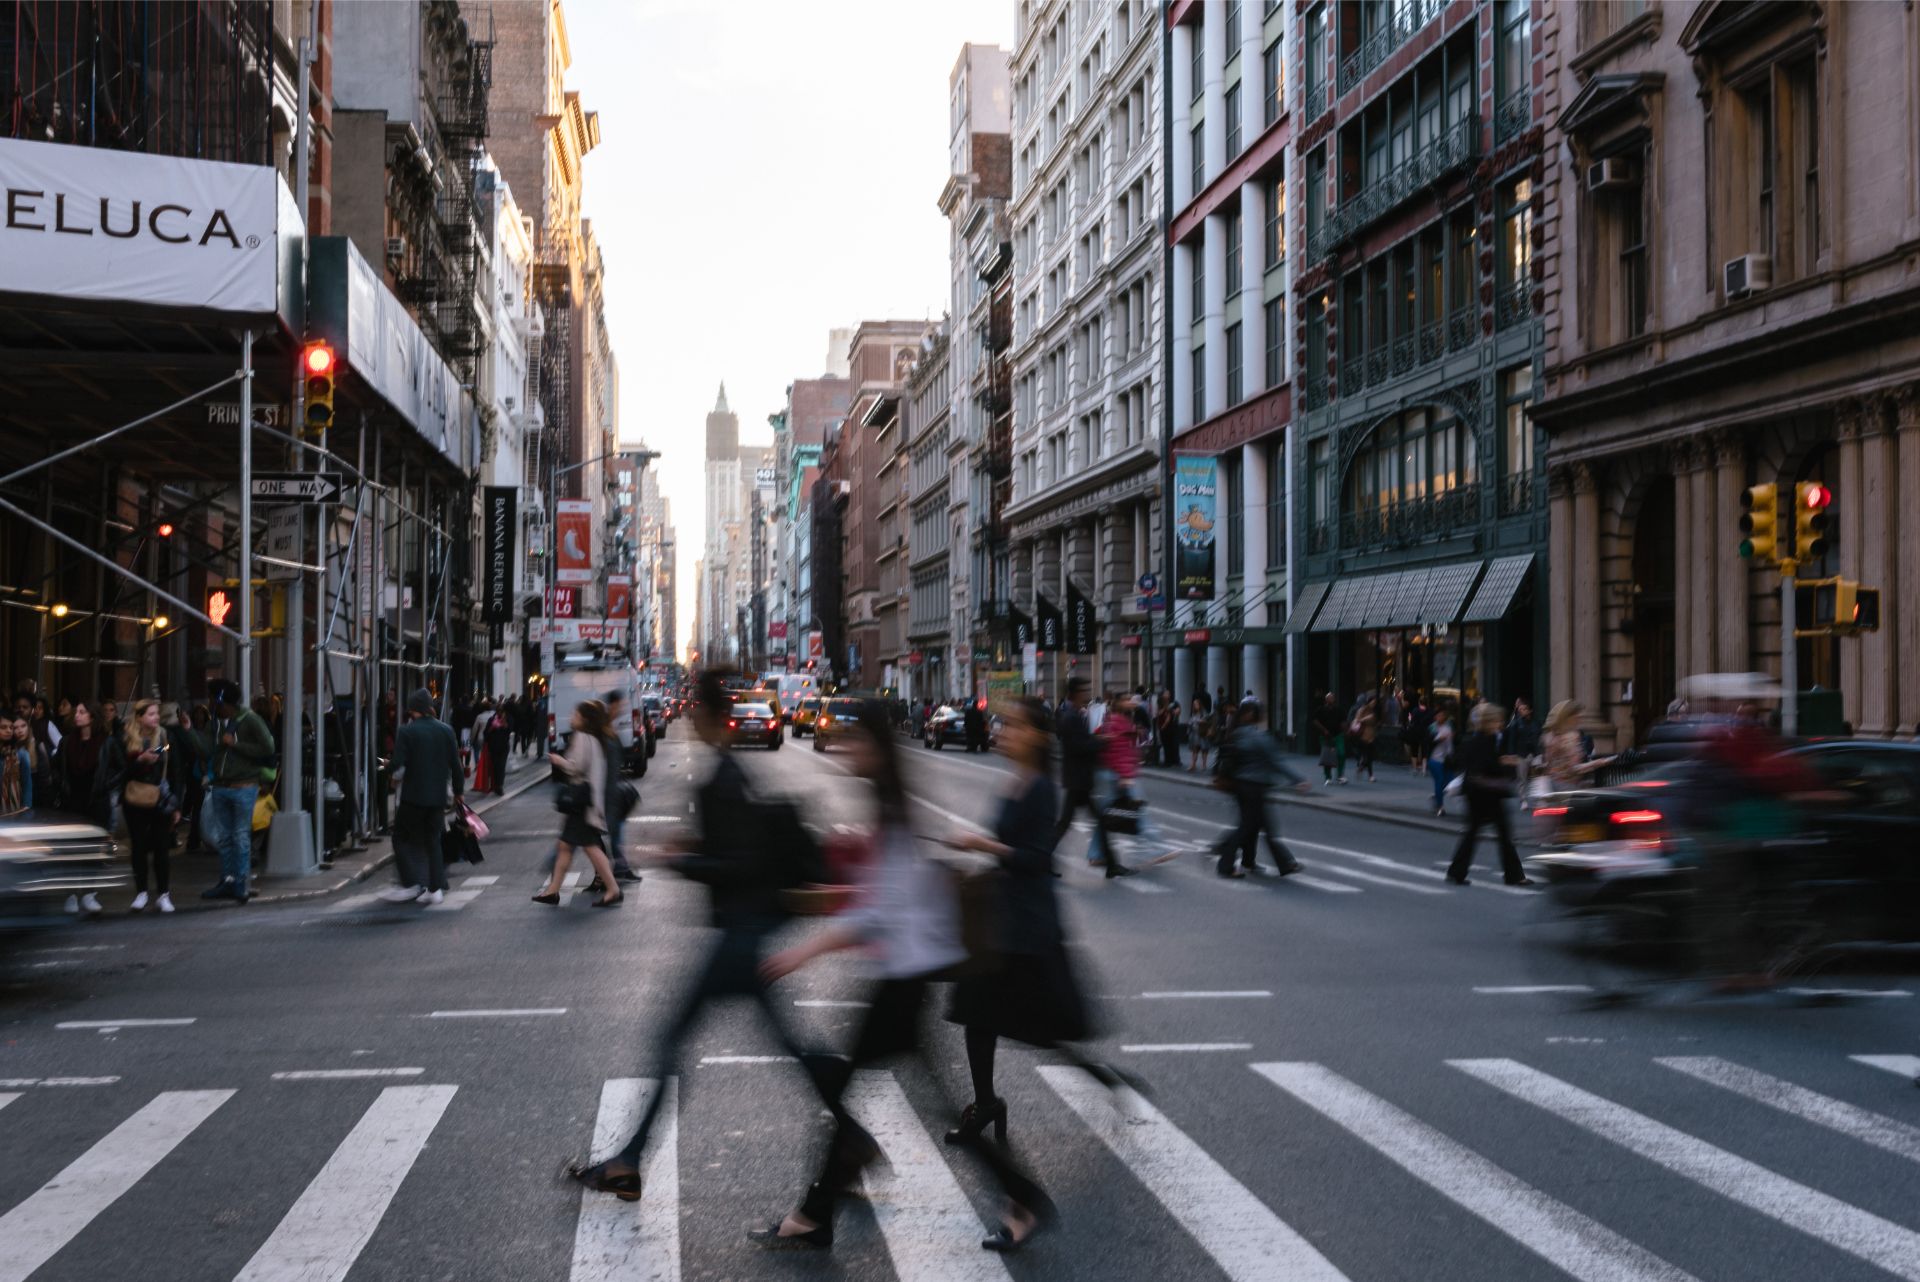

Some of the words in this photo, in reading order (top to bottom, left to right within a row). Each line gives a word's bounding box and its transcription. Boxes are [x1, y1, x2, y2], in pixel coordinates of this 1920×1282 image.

[207, 405, 257, 424] PRINE
[264, 407, 280, 426] ST
[259, 481, 286, 494] ONE
[300, 481, 327, 494] WAY
[1179, 484, 1197, 496] DOG
[1197, 484, 1215, 496] MAN
[494, 497, 505, 550] BANANA
[492, 551, 505, 612] REPUBLIC
[1076, 600, 1087, 654] SEPHORA
